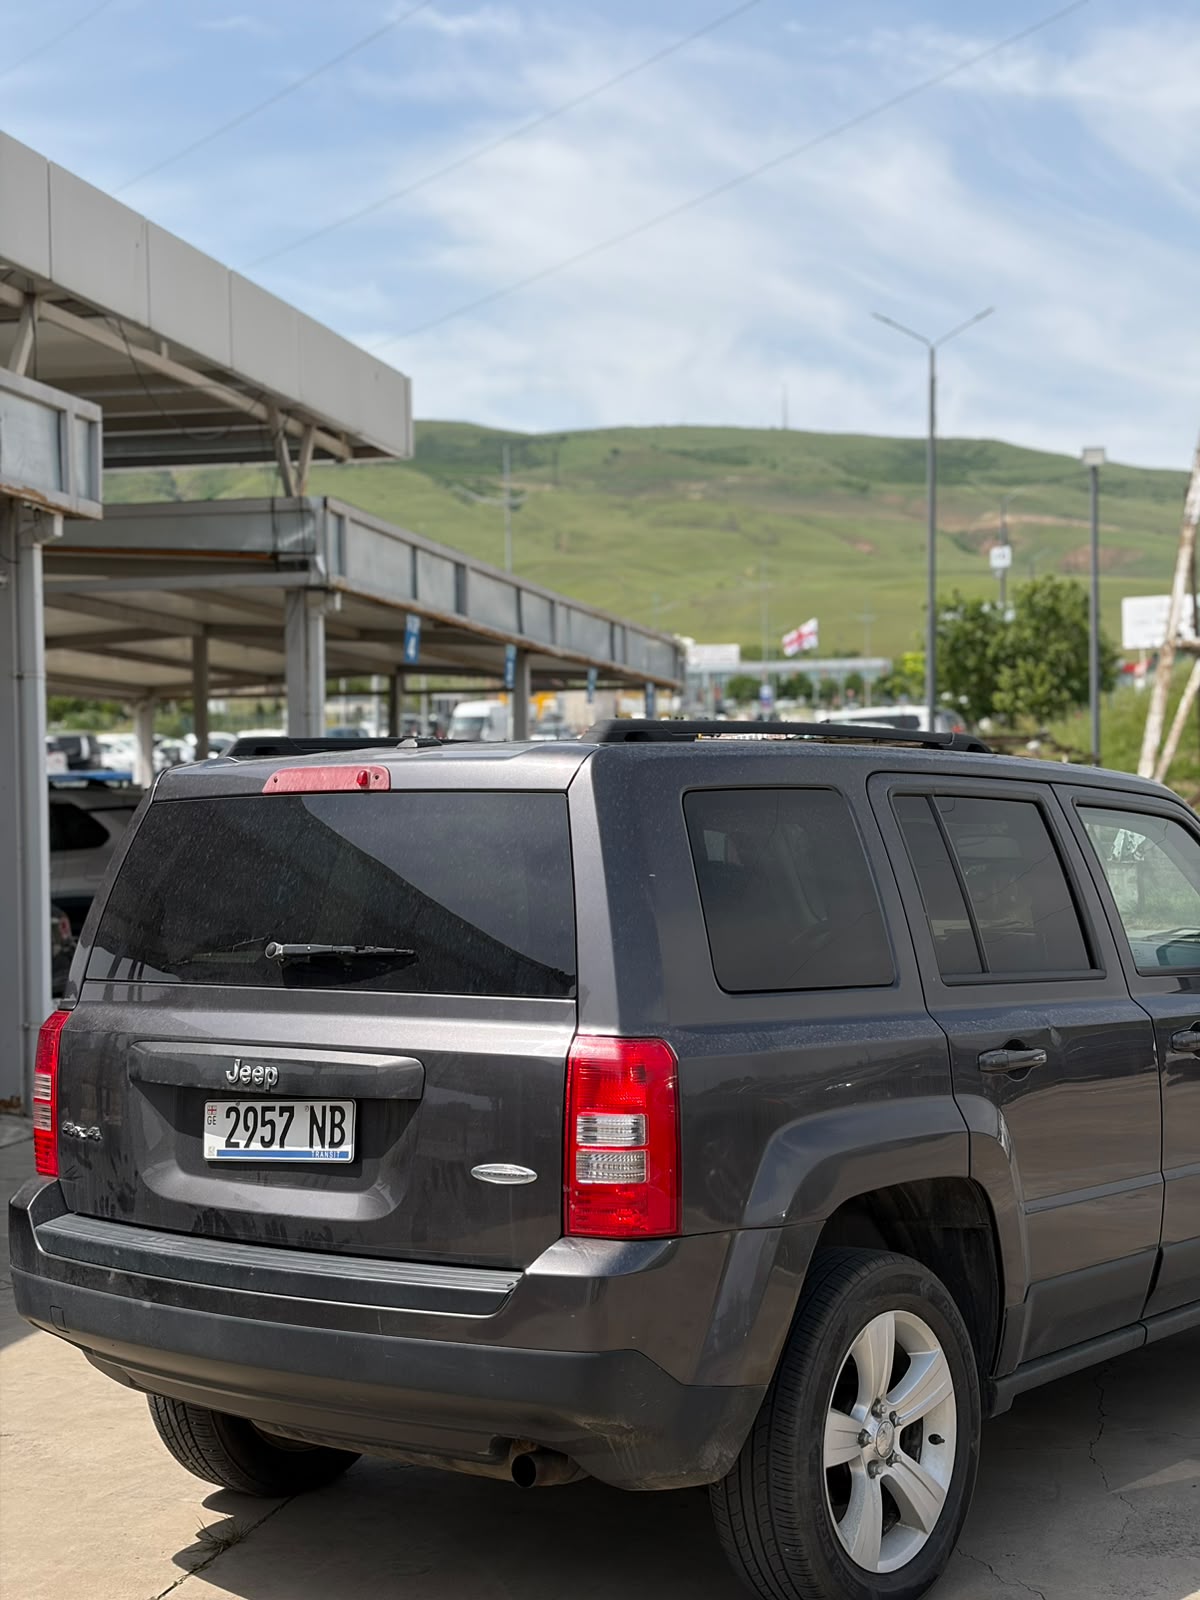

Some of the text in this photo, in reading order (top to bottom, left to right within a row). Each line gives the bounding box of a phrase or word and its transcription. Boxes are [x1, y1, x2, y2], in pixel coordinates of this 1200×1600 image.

[225, 1058, 279, 1091] Jeep
[207, 1115, 217, 1126] GE
[225, 1105, 346, 1149] 2957 NB
[311, 1151, 341, 1159] TRANSIT
